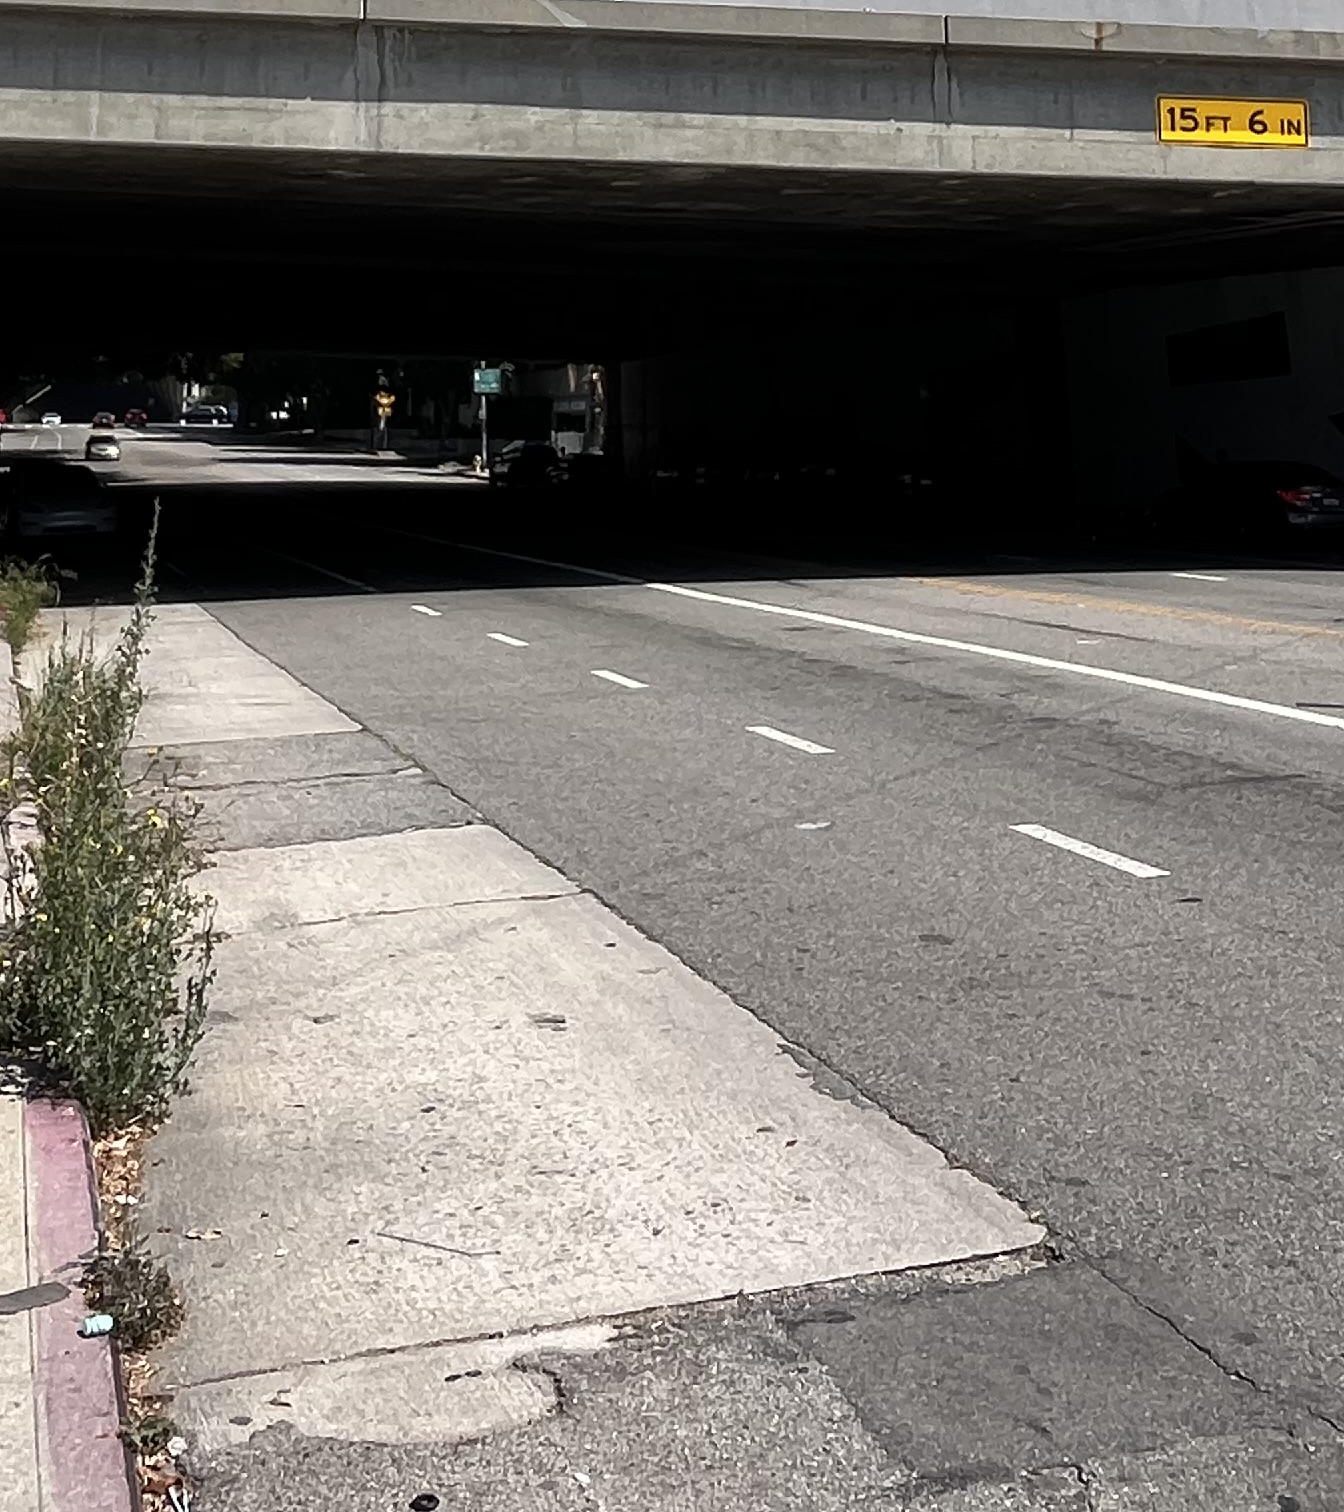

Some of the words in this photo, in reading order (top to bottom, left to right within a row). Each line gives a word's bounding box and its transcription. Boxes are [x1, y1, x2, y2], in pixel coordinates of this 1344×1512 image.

[1167, 107, 1199, 133] 15
[1205, 116, 1232, 133] FT
[1248, 110, 1268, 135] 6
[1280, 118, 1302, 136] IN
